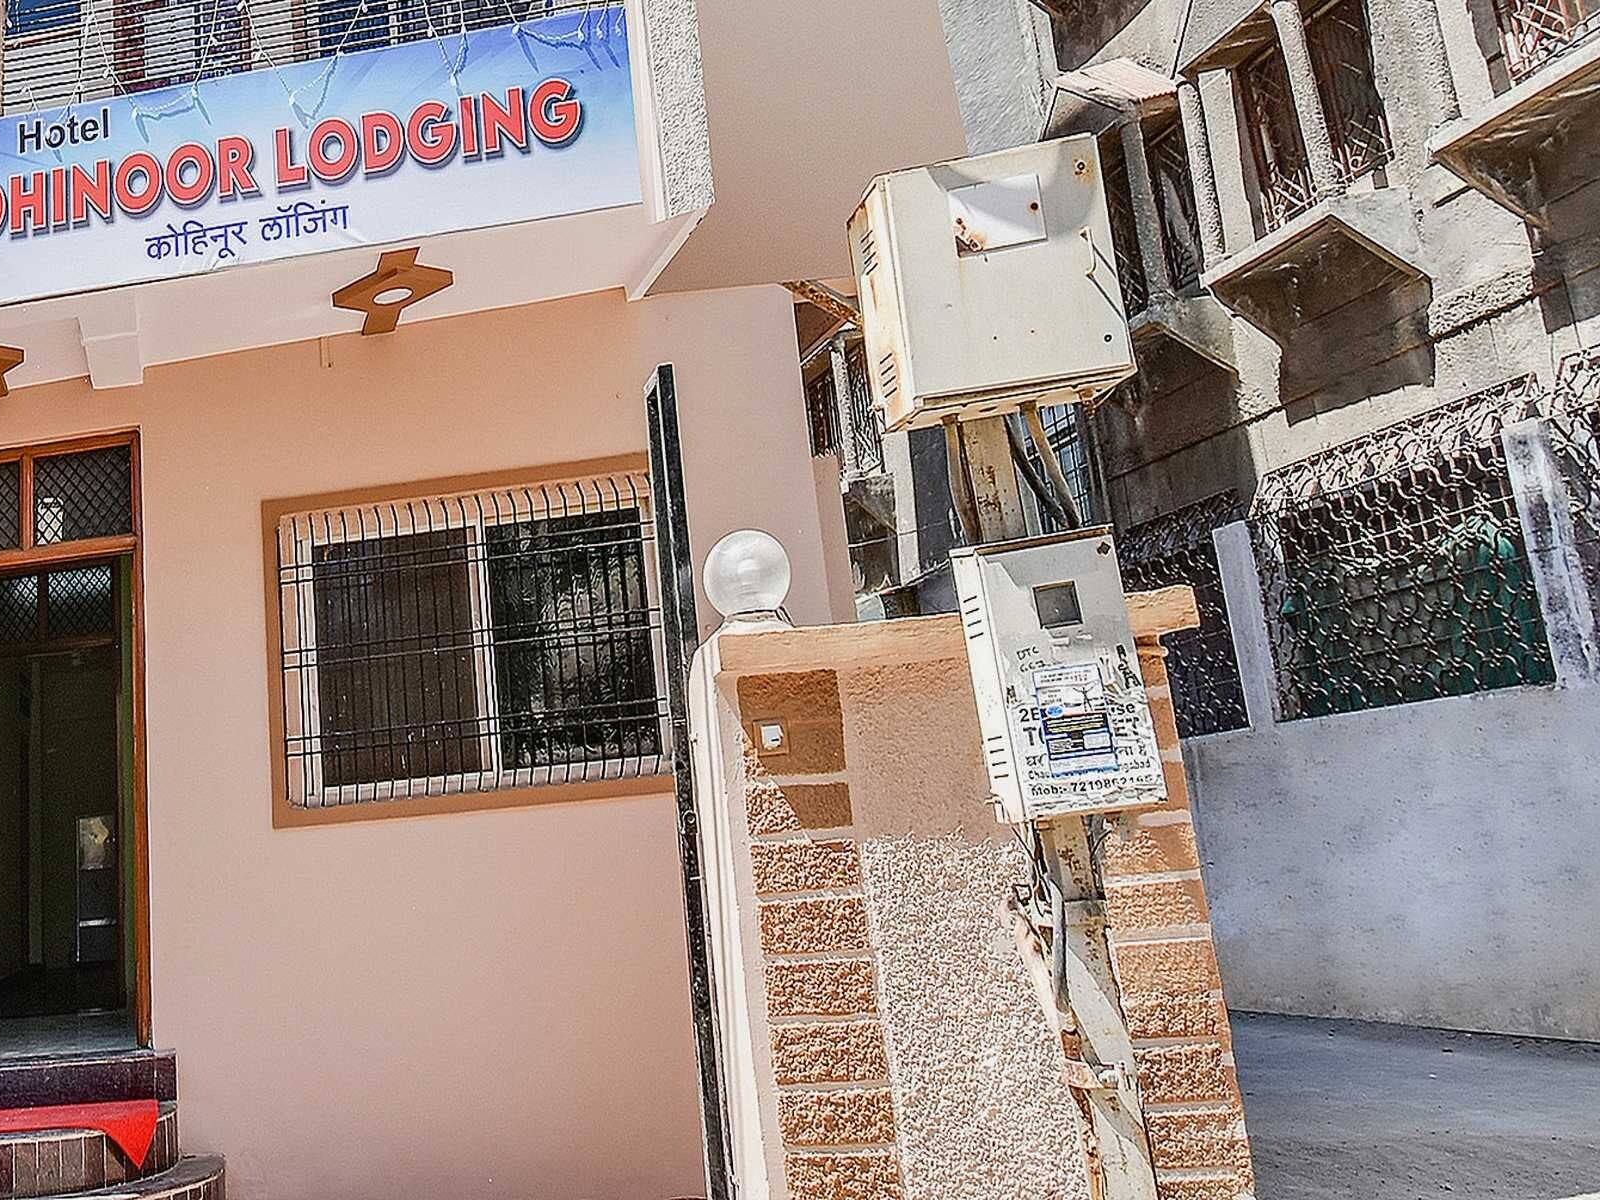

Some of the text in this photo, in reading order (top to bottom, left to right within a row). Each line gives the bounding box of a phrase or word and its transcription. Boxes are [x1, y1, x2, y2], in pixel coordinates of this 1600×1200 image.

[17, 108, 112, 154] Hotel
[274, 80, 582, 188] LODGING
[145, 197, 350, 264] कोहिनूर लॉजिंग
